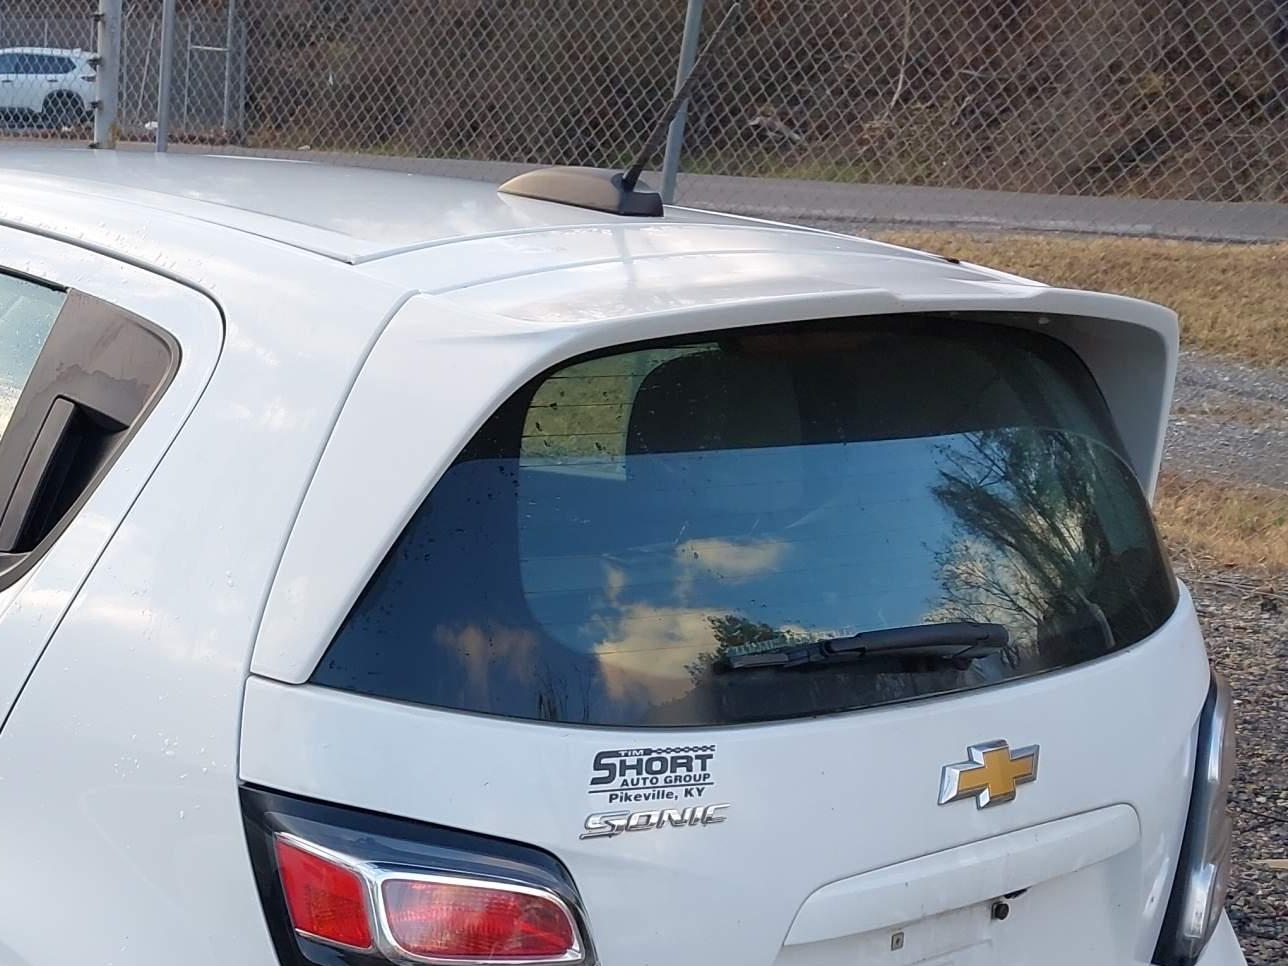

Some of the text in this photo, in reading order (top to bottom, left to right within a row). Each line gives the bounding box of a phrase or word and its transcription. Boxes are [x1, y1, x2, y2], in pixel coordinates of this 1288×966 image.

[618, 749, 644, 757] TIM
[590, 748, 714, 785] SHORT
[620, 773, 711, 788] AUTO GROUP
[608, 787, 705, 804] Pikeville, KY
[579, 803, 732, 841] SONIC
